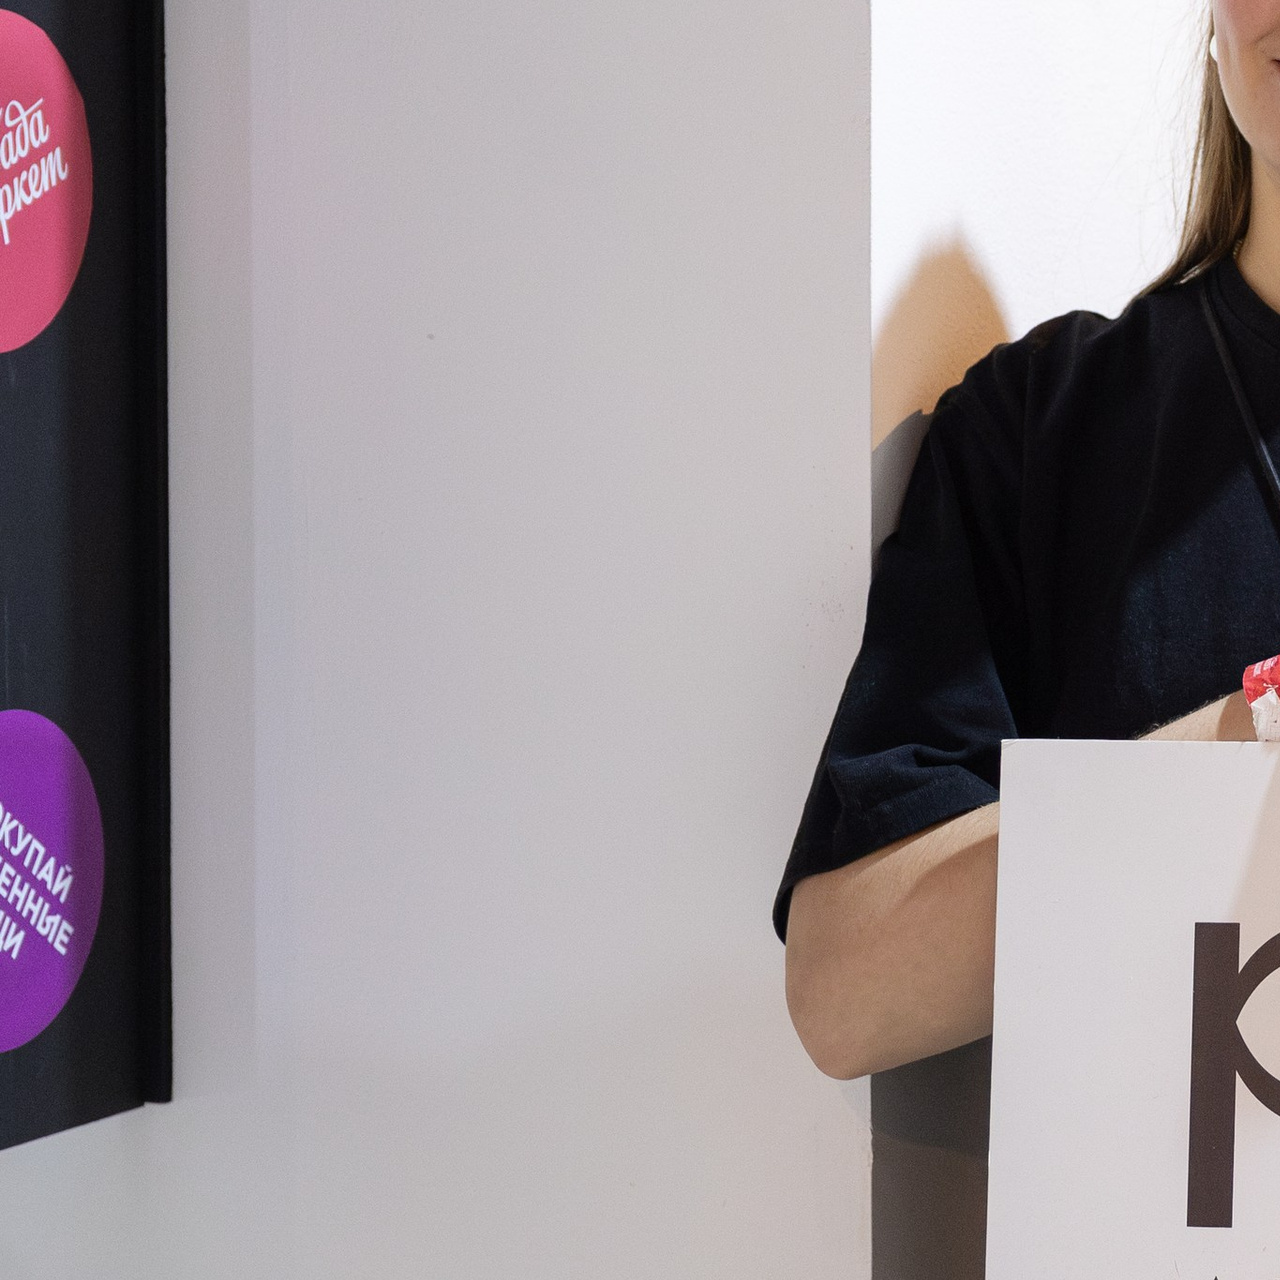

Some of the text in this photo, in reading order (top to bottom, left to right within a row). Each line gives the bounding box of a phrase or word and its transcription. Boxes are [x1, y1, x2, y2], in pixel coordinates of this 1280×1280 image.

[0, 97, 49, 170] ада
[0, 801, 74, 904] КУПАЙ
[0, 856, 75, 956] ЕННЫЕ
